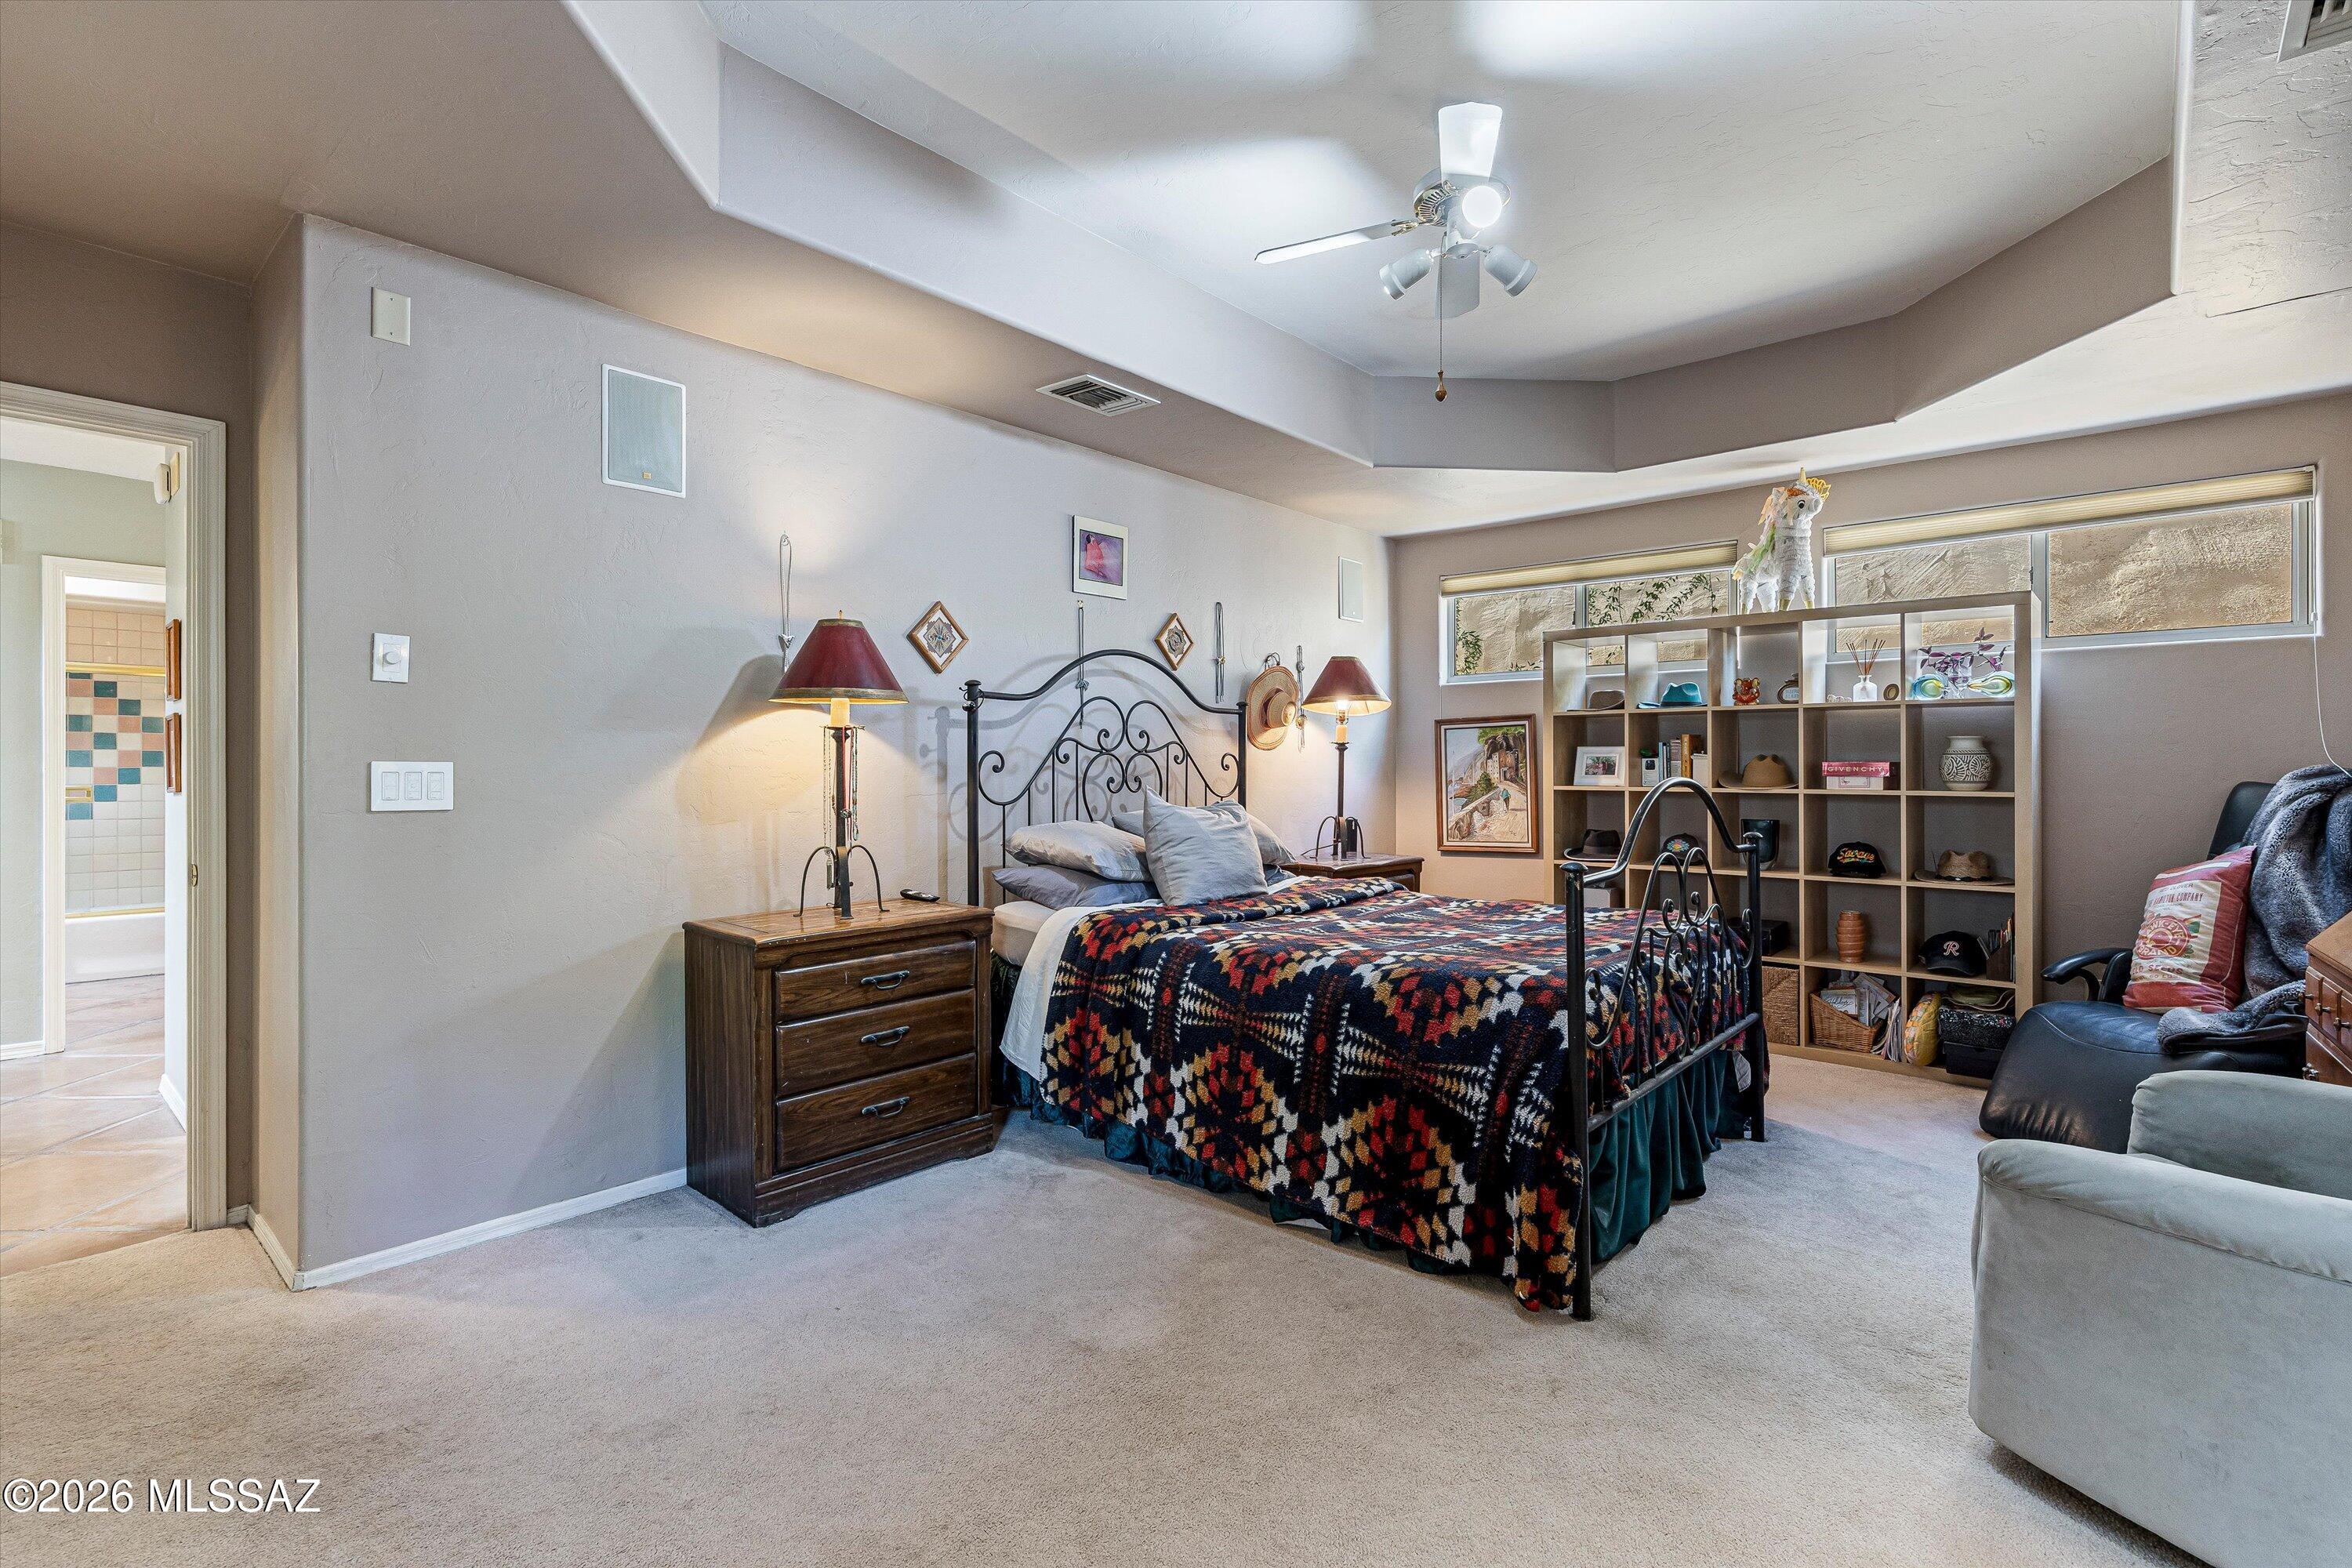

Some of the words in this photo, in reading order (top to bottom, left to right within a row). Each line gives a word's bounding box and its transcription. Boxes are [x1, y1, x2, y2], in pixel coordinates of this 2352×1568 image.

[2176, 893, 2204, 902] COMPANY
[2147, 920, 2186, 938] AWK-EYE
[1943, 941, 1960, 956] R
[2138, 944, 2177, 956] BRAND
